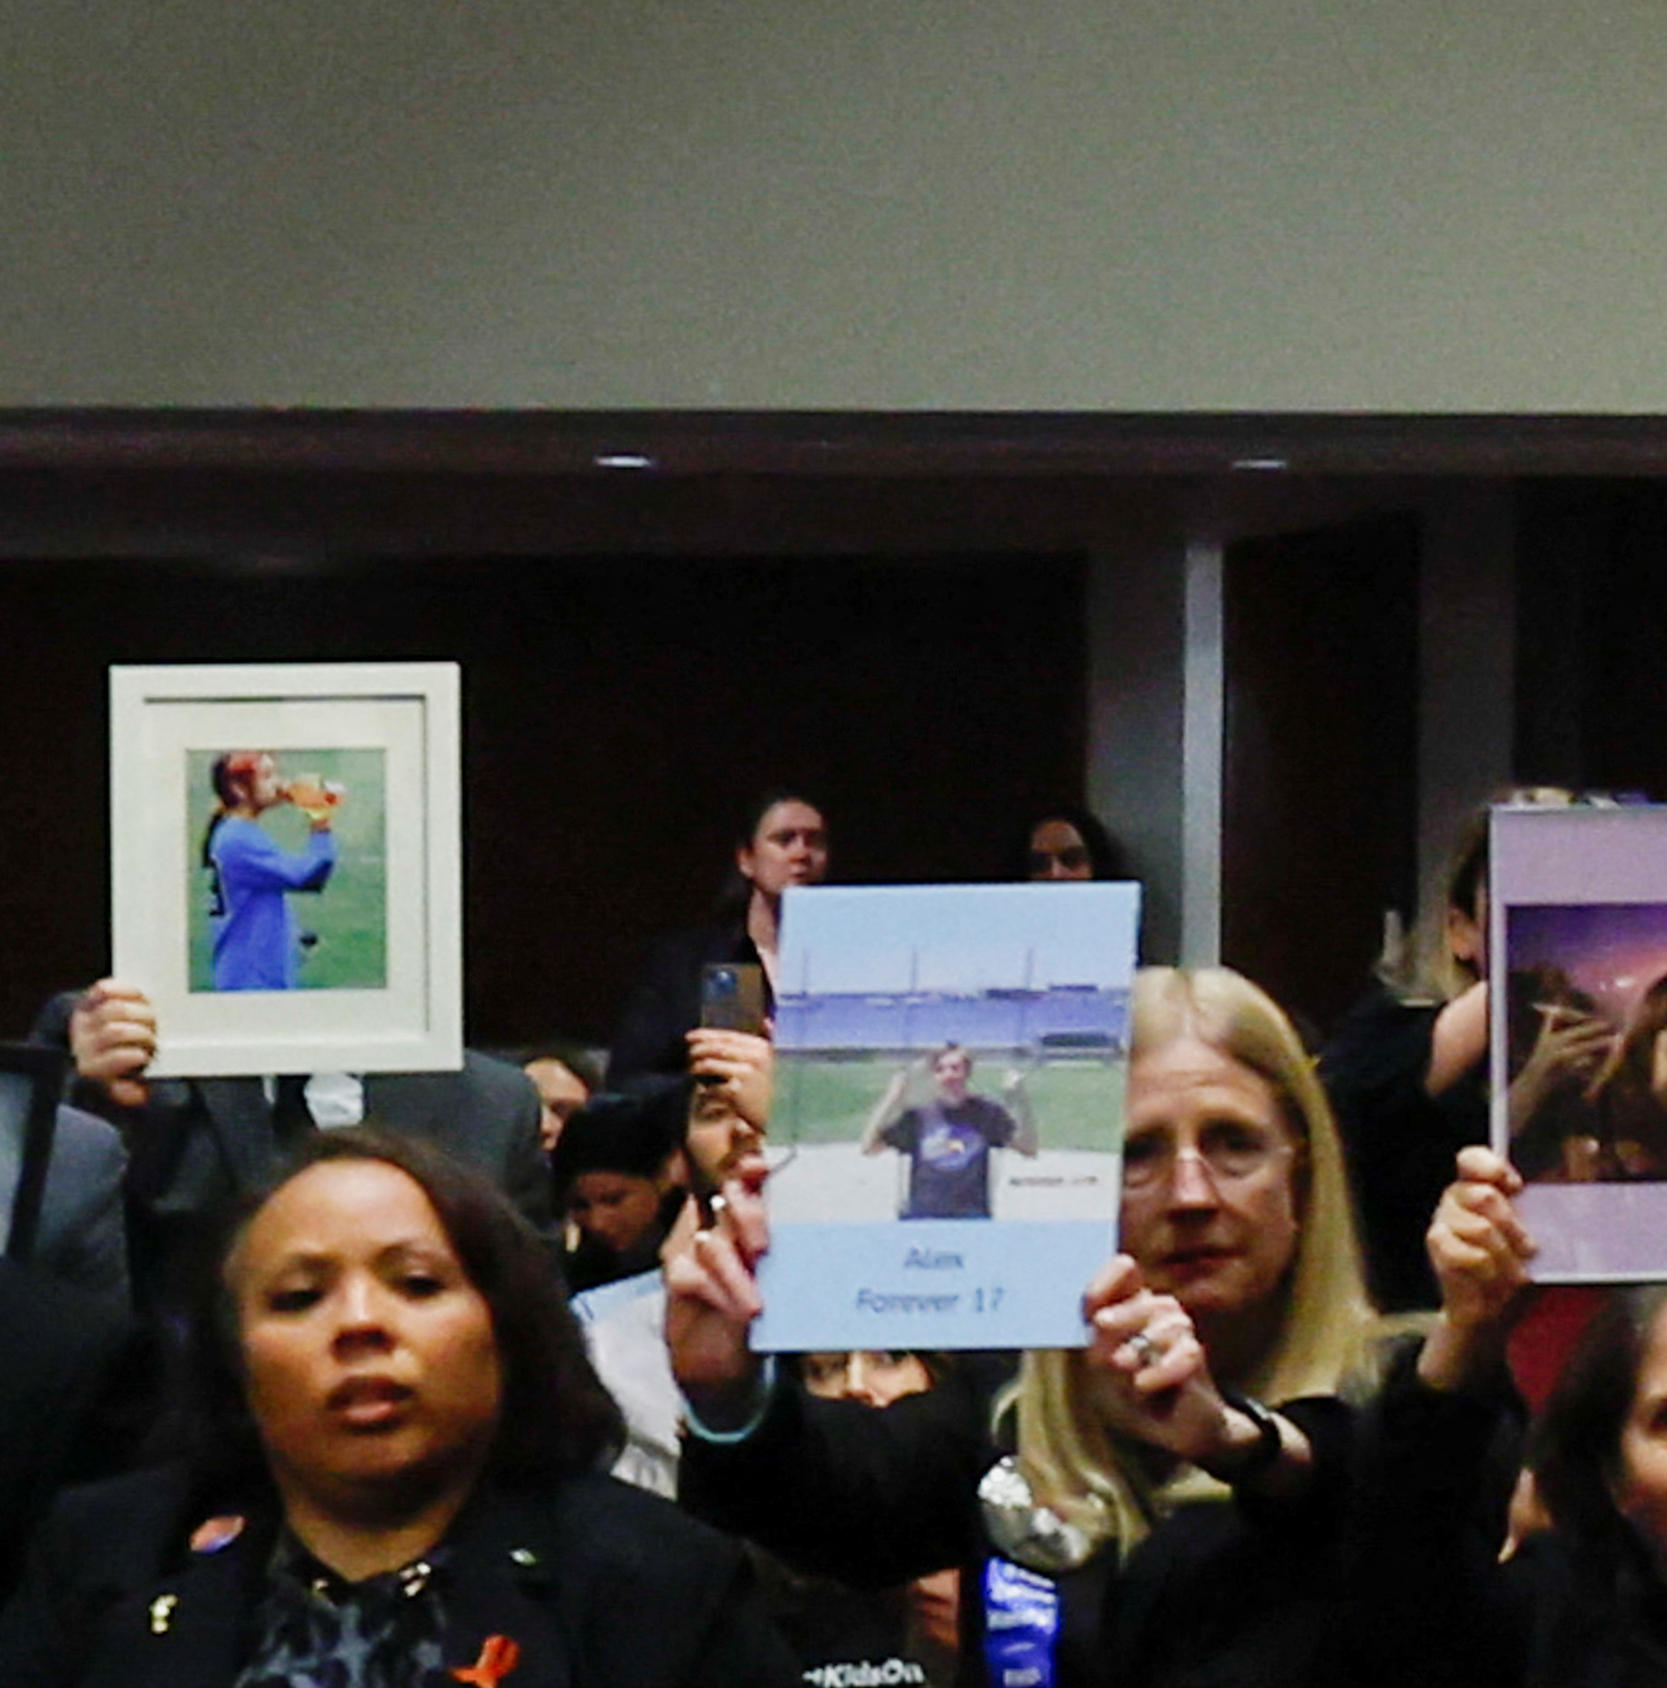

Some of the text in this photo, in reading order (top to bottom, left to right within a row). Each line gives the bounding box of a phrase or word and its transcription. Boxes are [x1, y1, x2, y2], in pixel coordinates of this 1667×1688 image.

[904, 1248, 964, 1269] Alex
[857, 1287, 1003, 1313] Forever 17
